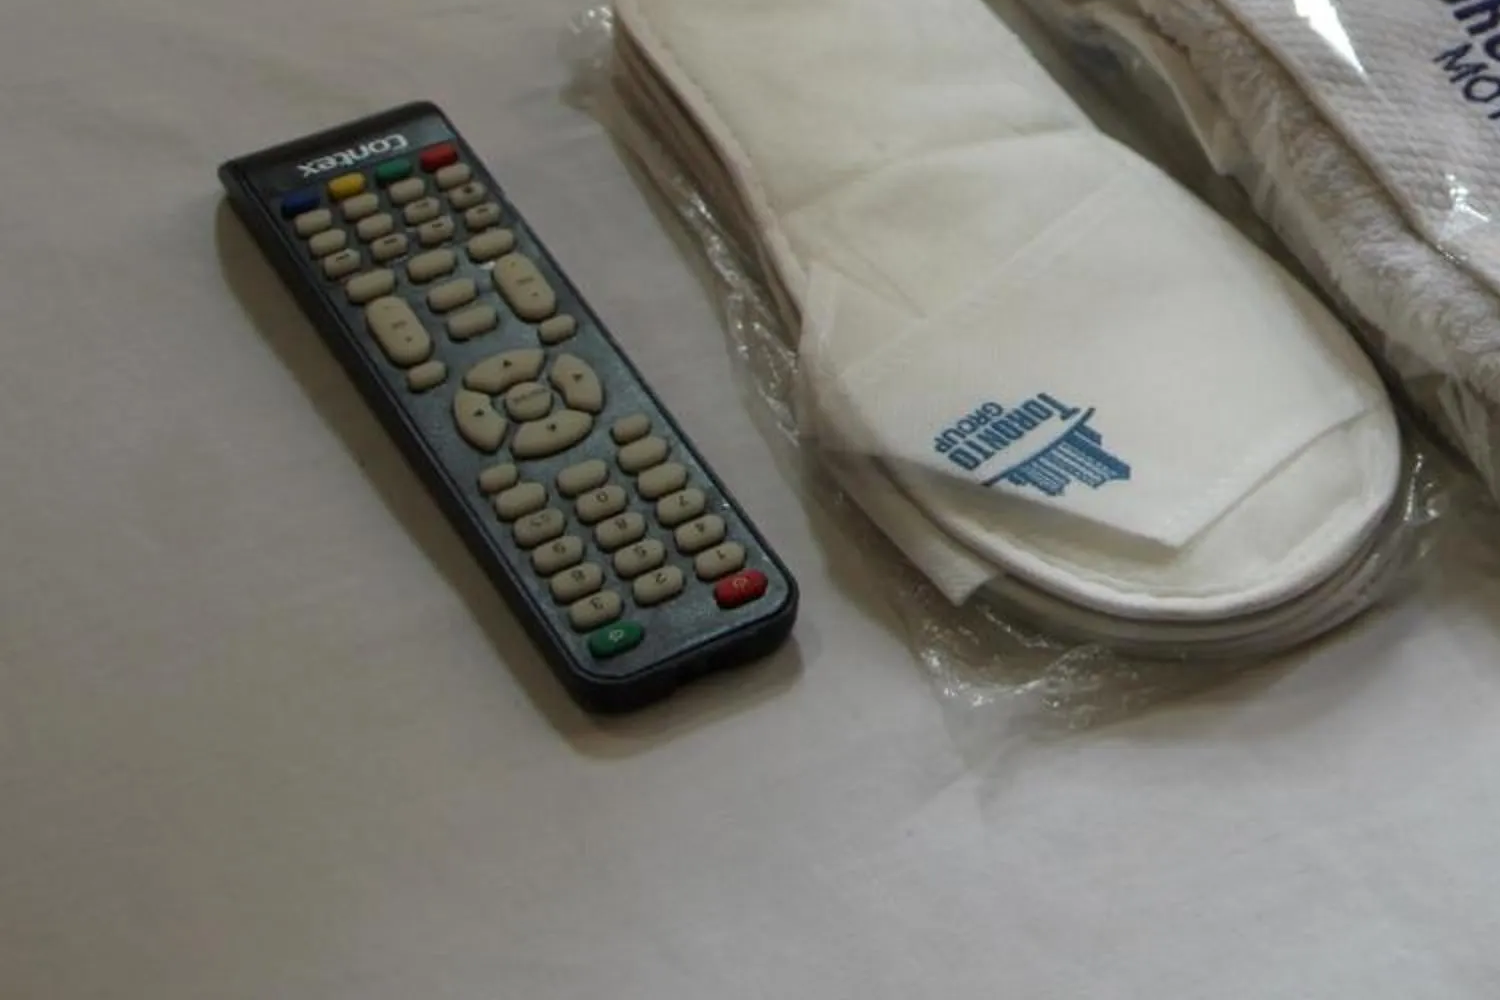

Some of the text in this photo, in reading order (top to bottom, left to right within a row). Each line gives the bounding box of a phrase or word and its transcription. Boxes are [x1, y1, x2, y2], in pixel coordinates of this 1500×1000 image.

[296, 133, 408, 177] contex
[934, 401, 1003, 453] GROUP
[948, 392, 1080, 471] TORONTO
